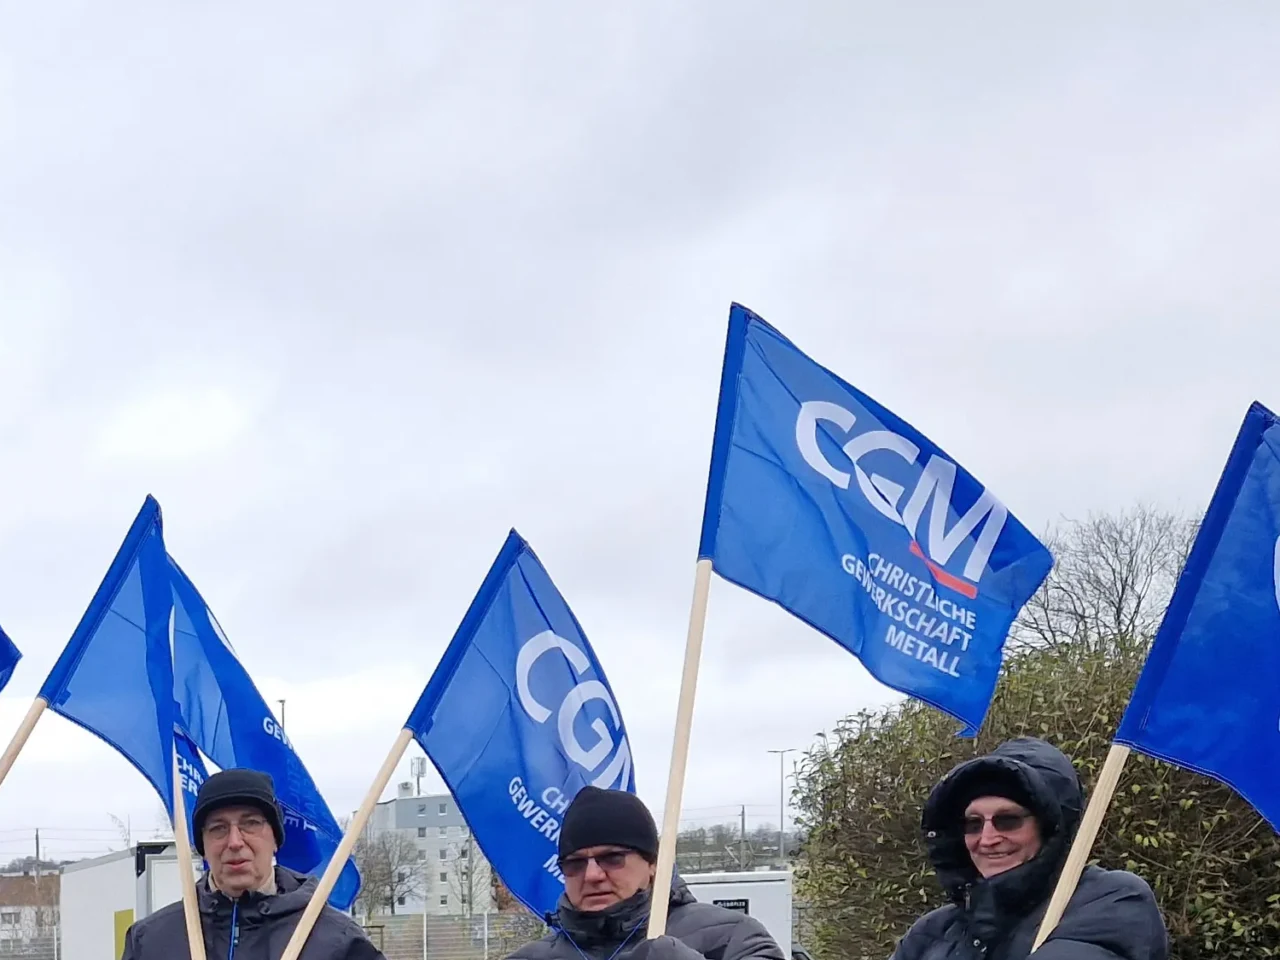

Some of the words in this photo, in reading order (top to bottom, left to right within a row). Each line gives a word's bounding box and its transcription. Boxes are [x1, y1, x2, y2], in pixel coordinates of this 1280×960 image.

[795, 400, 1007, 583] CGM
[841, 554, 972, 653] GEWERKSCHAFT
[868, 553, 976, 630] CHRISTLICHE
[884, 624, 960, 678] METALL
